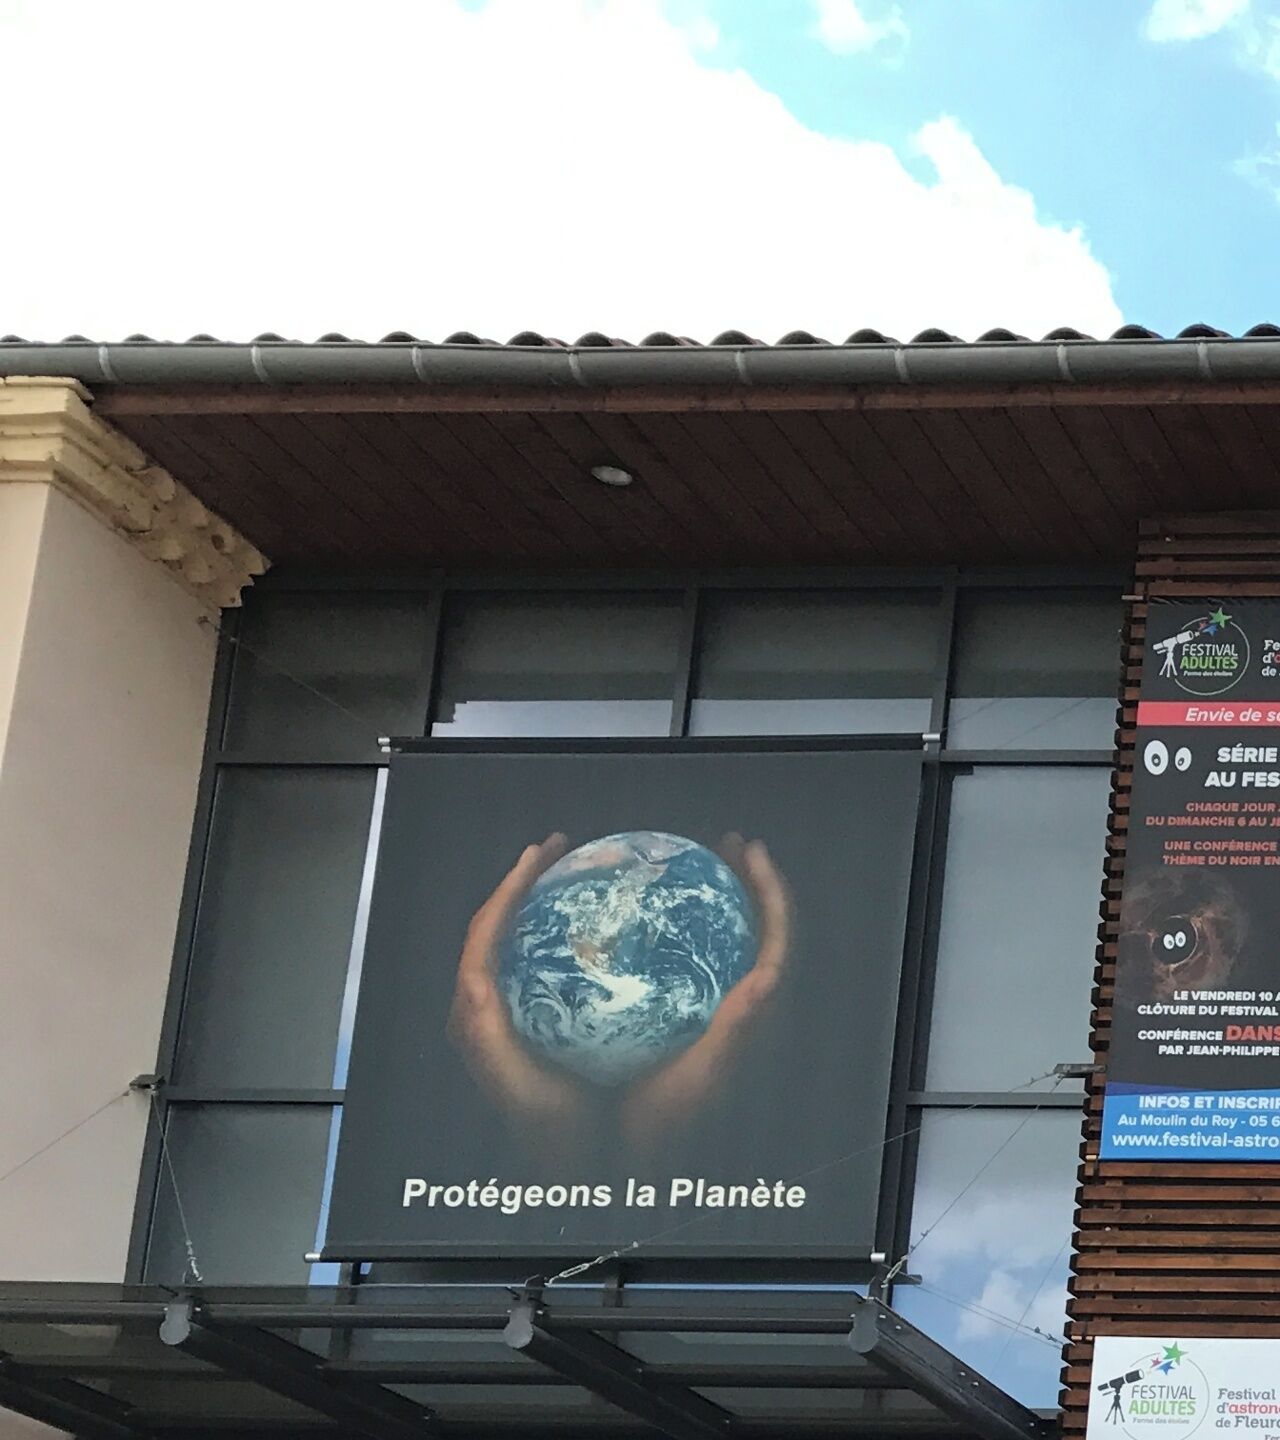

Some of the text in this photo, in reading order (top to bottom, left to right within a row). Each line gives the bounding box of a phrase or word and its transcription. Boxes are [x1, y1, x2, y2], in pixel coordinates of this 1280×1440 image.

[1182, 644, 1238, 656] FESTIVAL
[1180, 657, 1238, 669] ADULTES
[1262, 666, 1276, 676] de
[1186, 708, 1234, 722] Envie
[1240, 709, 1260, 721] de
[1218, 743, 1277, 763] SÉRIE
[1204, 772, 1235, 787] AU
[1165, 841, 1191, 850] UNE
[1193, 840, 1277, 851] CONFÉRENCE
[1163, 854, 1205, 865] THÈME
[1208, 856, 1227, 865] DU
[1230, 856, 1262, 865] NOIR
[1265, 857, 1280, 865] EN
[1174, 991, 1189, 1000] LE
[1192, 991, 1255, 1001] VENDREDI
[1259, 992, 1273, 1001] 10
[1138, 1004, 1196, 1016] CLÔTURE
[1199, 1006, 1218, 1015] DU
[1221, 1006, 1278, 1016] FESTIVAL
[1138, 1029, 1223, 1041] CONFÉRENCE
[1159, 1046, 1183, 1055] PAR
[1187, 1046, 1280, 1056] JEAN-PHILIPPE
[1139, 1097, 1190, 1108] INFOS
[1194, 1097, 1214, 1109] ET
[1118, 1115, 1136, 1126] Au
[1141, 1115, 1187, 1126] Moulin
[1190, 1115, 1209, 1126] du
[1212, 1116, 1236, 1129] Roy
[1249, 1117, 1268, 1127] 05
[402, 1177, 807, 1215] Protégeons la Planète
[1131, 1385, 1196, 1399] FESTIVAL
[1218, 1388, 1275, 1401] Festival
[1129, 1401, 1196, 1415] ADULTES
[1215, 1417, 1231, 1428] de
